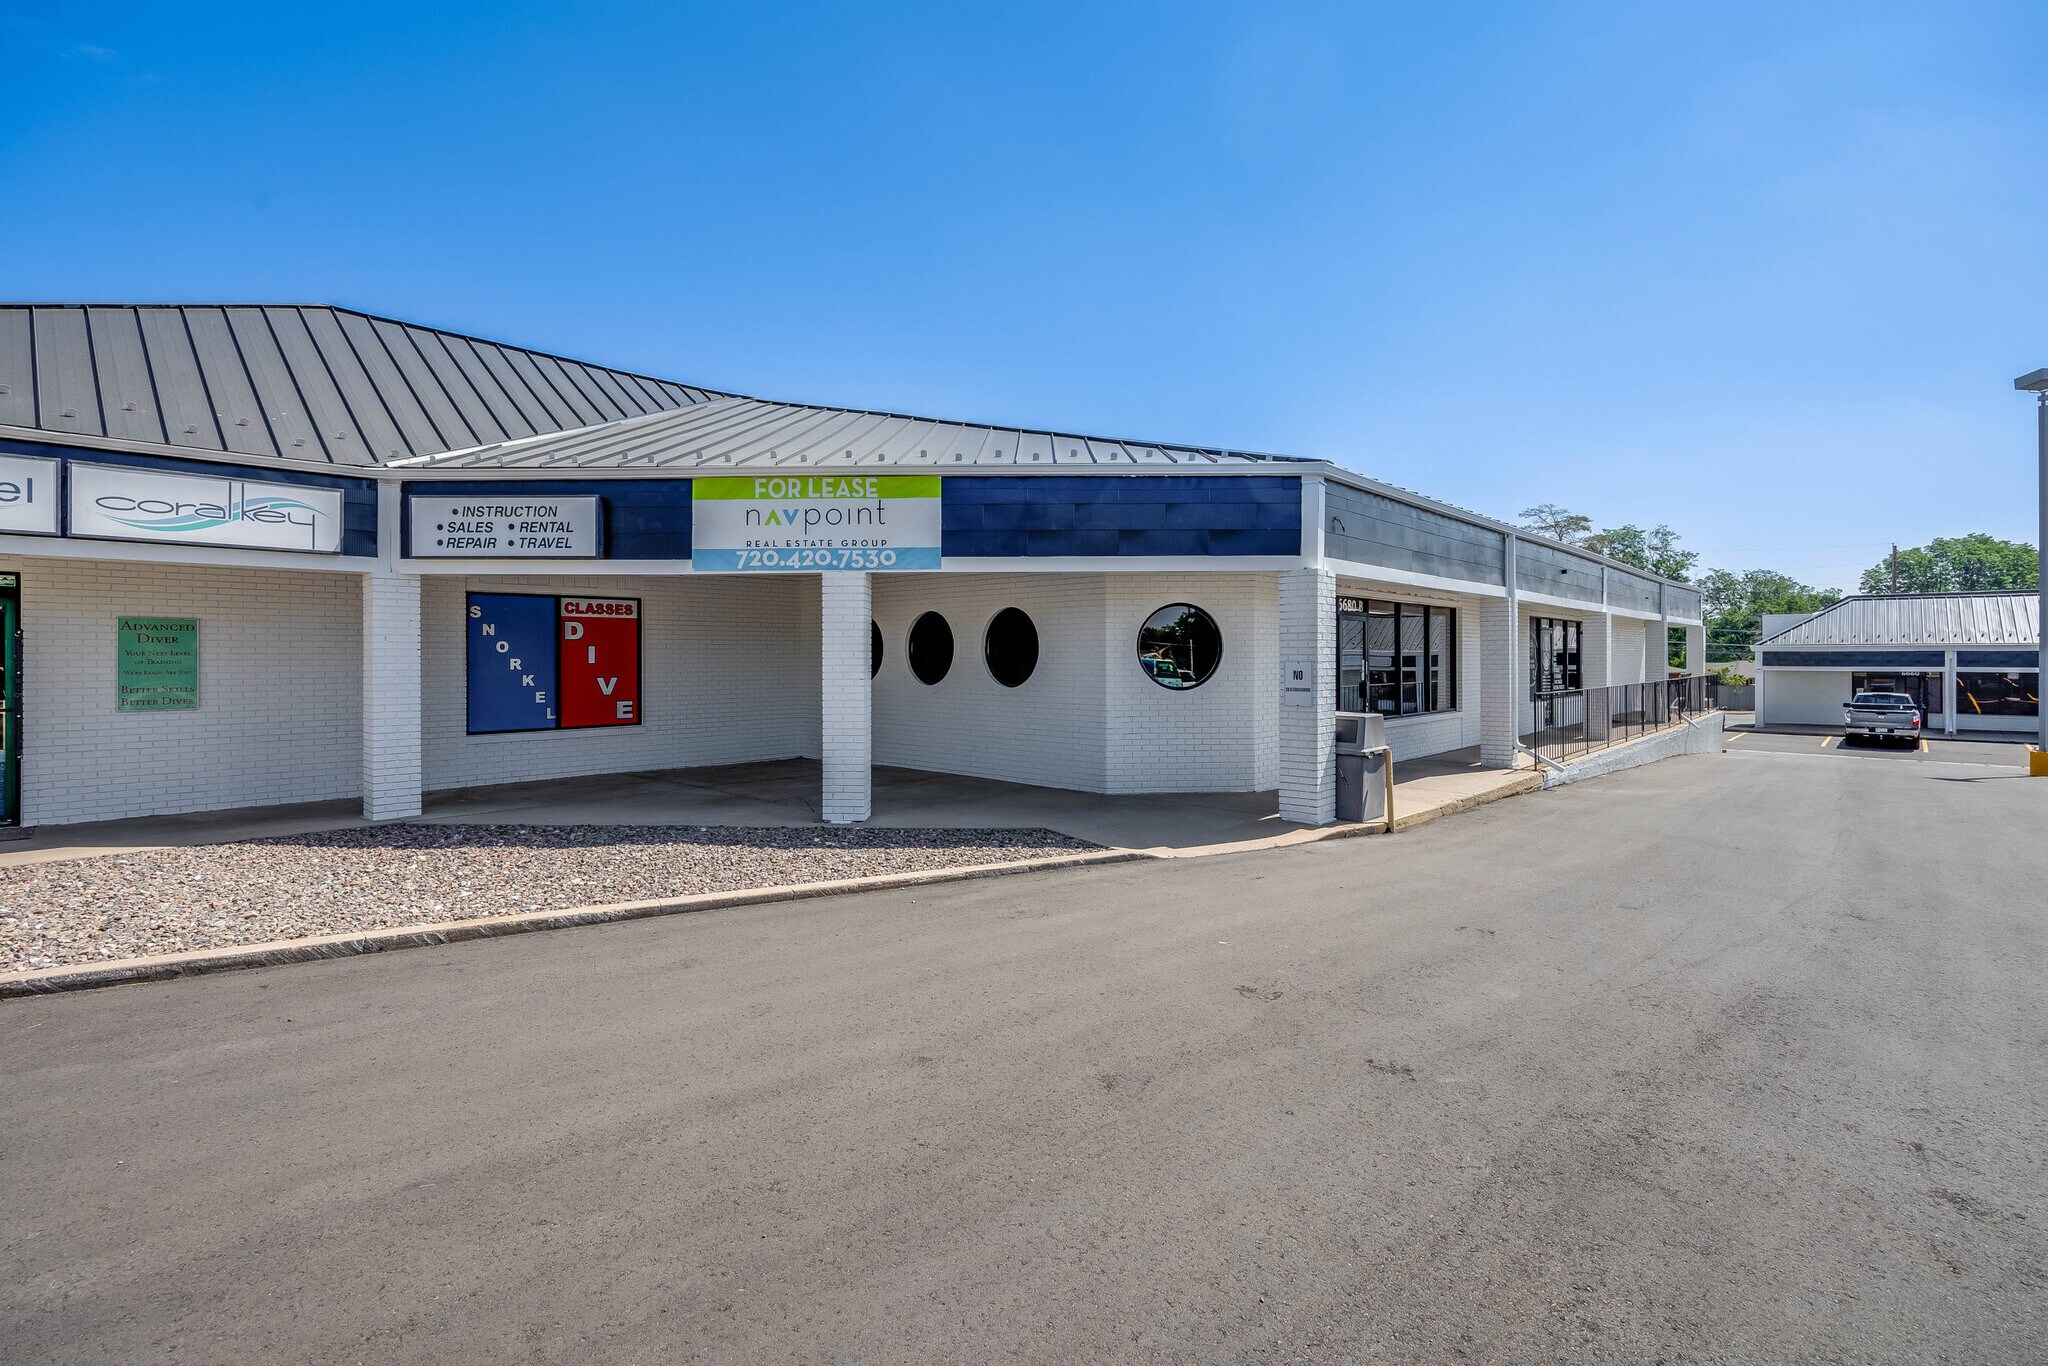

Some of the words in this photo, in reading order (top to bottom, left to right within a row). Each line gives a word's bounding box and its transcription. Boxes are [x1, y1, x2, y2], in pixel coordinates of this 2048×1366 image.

[754, 478, 801, 498] FOR
[808, 478, 878, 498] LEASE
[461, 506, 558, 517] INSTRUCTION
[746, 499, 886, 535] navpoint
[447, 521, 494, 533] SALES
[519, 521, 574, 533] RENTAL
[446, 537, 497, 548] REPAIR
[519, 537, 573, 548] TRAVEL
[746, 540, 778, 548] REAL
[786, 539, 833, 547] ESTATE
[841, 539, 888, 547] GROUP
[736, 550, 897, 569] 720.420.7530
[564, 602, 634, 616] CLASSES
[121, 620, 195, 631] ADVANCED
[137, 633, 180, 644] DIVER
[469, 606, 556, 719] SNORKEL
[564, 621, 634, 719] DIVE
[1292, 670, 1304, 681] NO
[121, 685, 159, 694] BETTER
[162, 684, 195, 693] SKILLS
[121, 697, 159, 706] BETTER
[162, 696, 195, 705] DIVER
